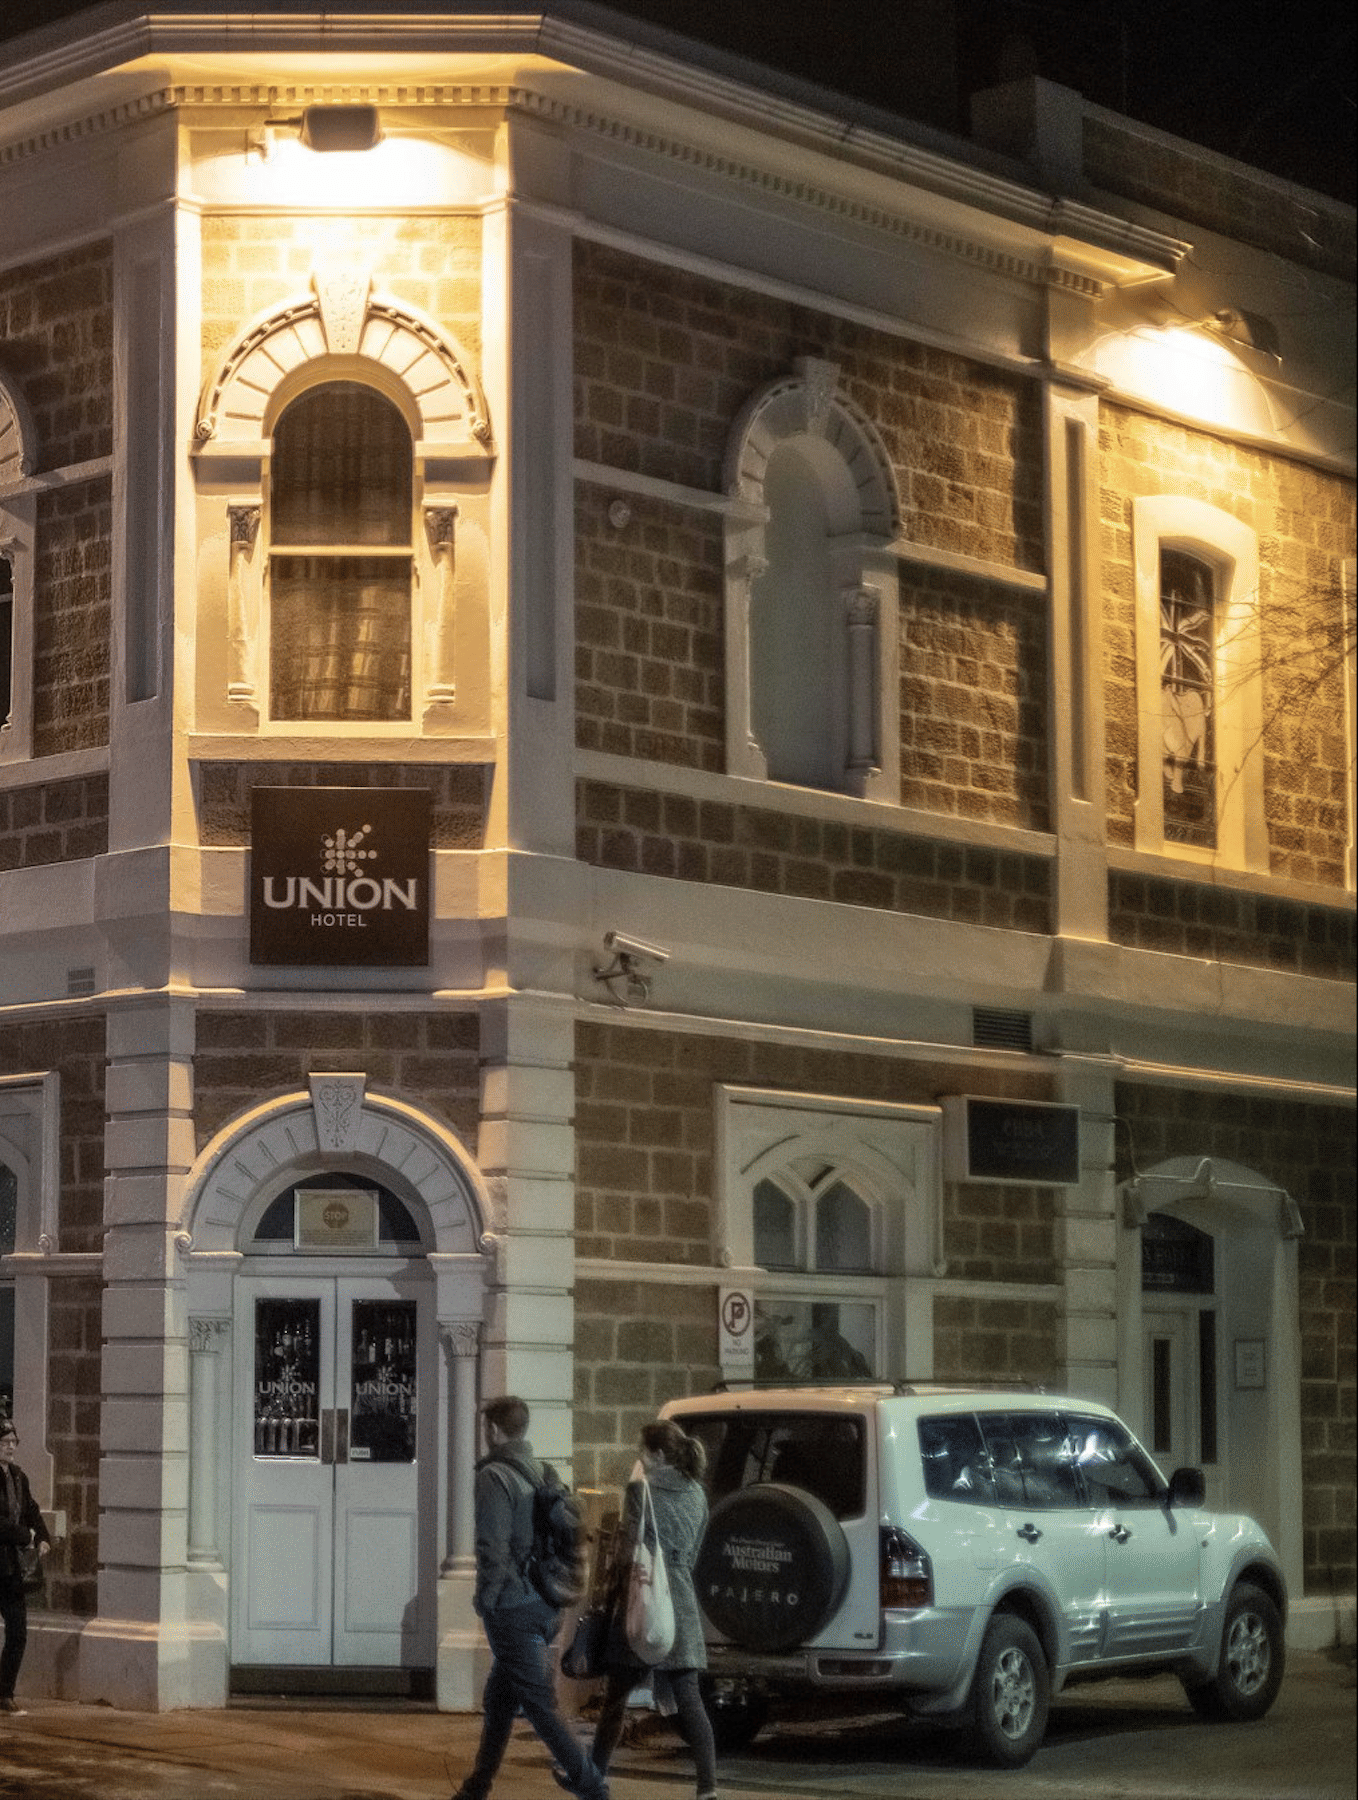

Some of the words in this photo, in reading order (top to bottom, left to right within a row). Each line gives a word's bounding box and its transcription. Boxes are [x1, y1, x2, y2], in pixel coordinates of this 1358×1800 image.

[263, 877, 417, 910] UNION
[311, 914, 367, 927] HOTEL
[324, 1211, 348, 1220] STOP
[259, 1381, 315, 1394] UNION
[355, 1382, 412, 1396] UNION
[723, 1542, 793, 1562] Australian
[732, 1556, 780, 1573] Motors
[711, 1585, 799, 1605] PAJERO
